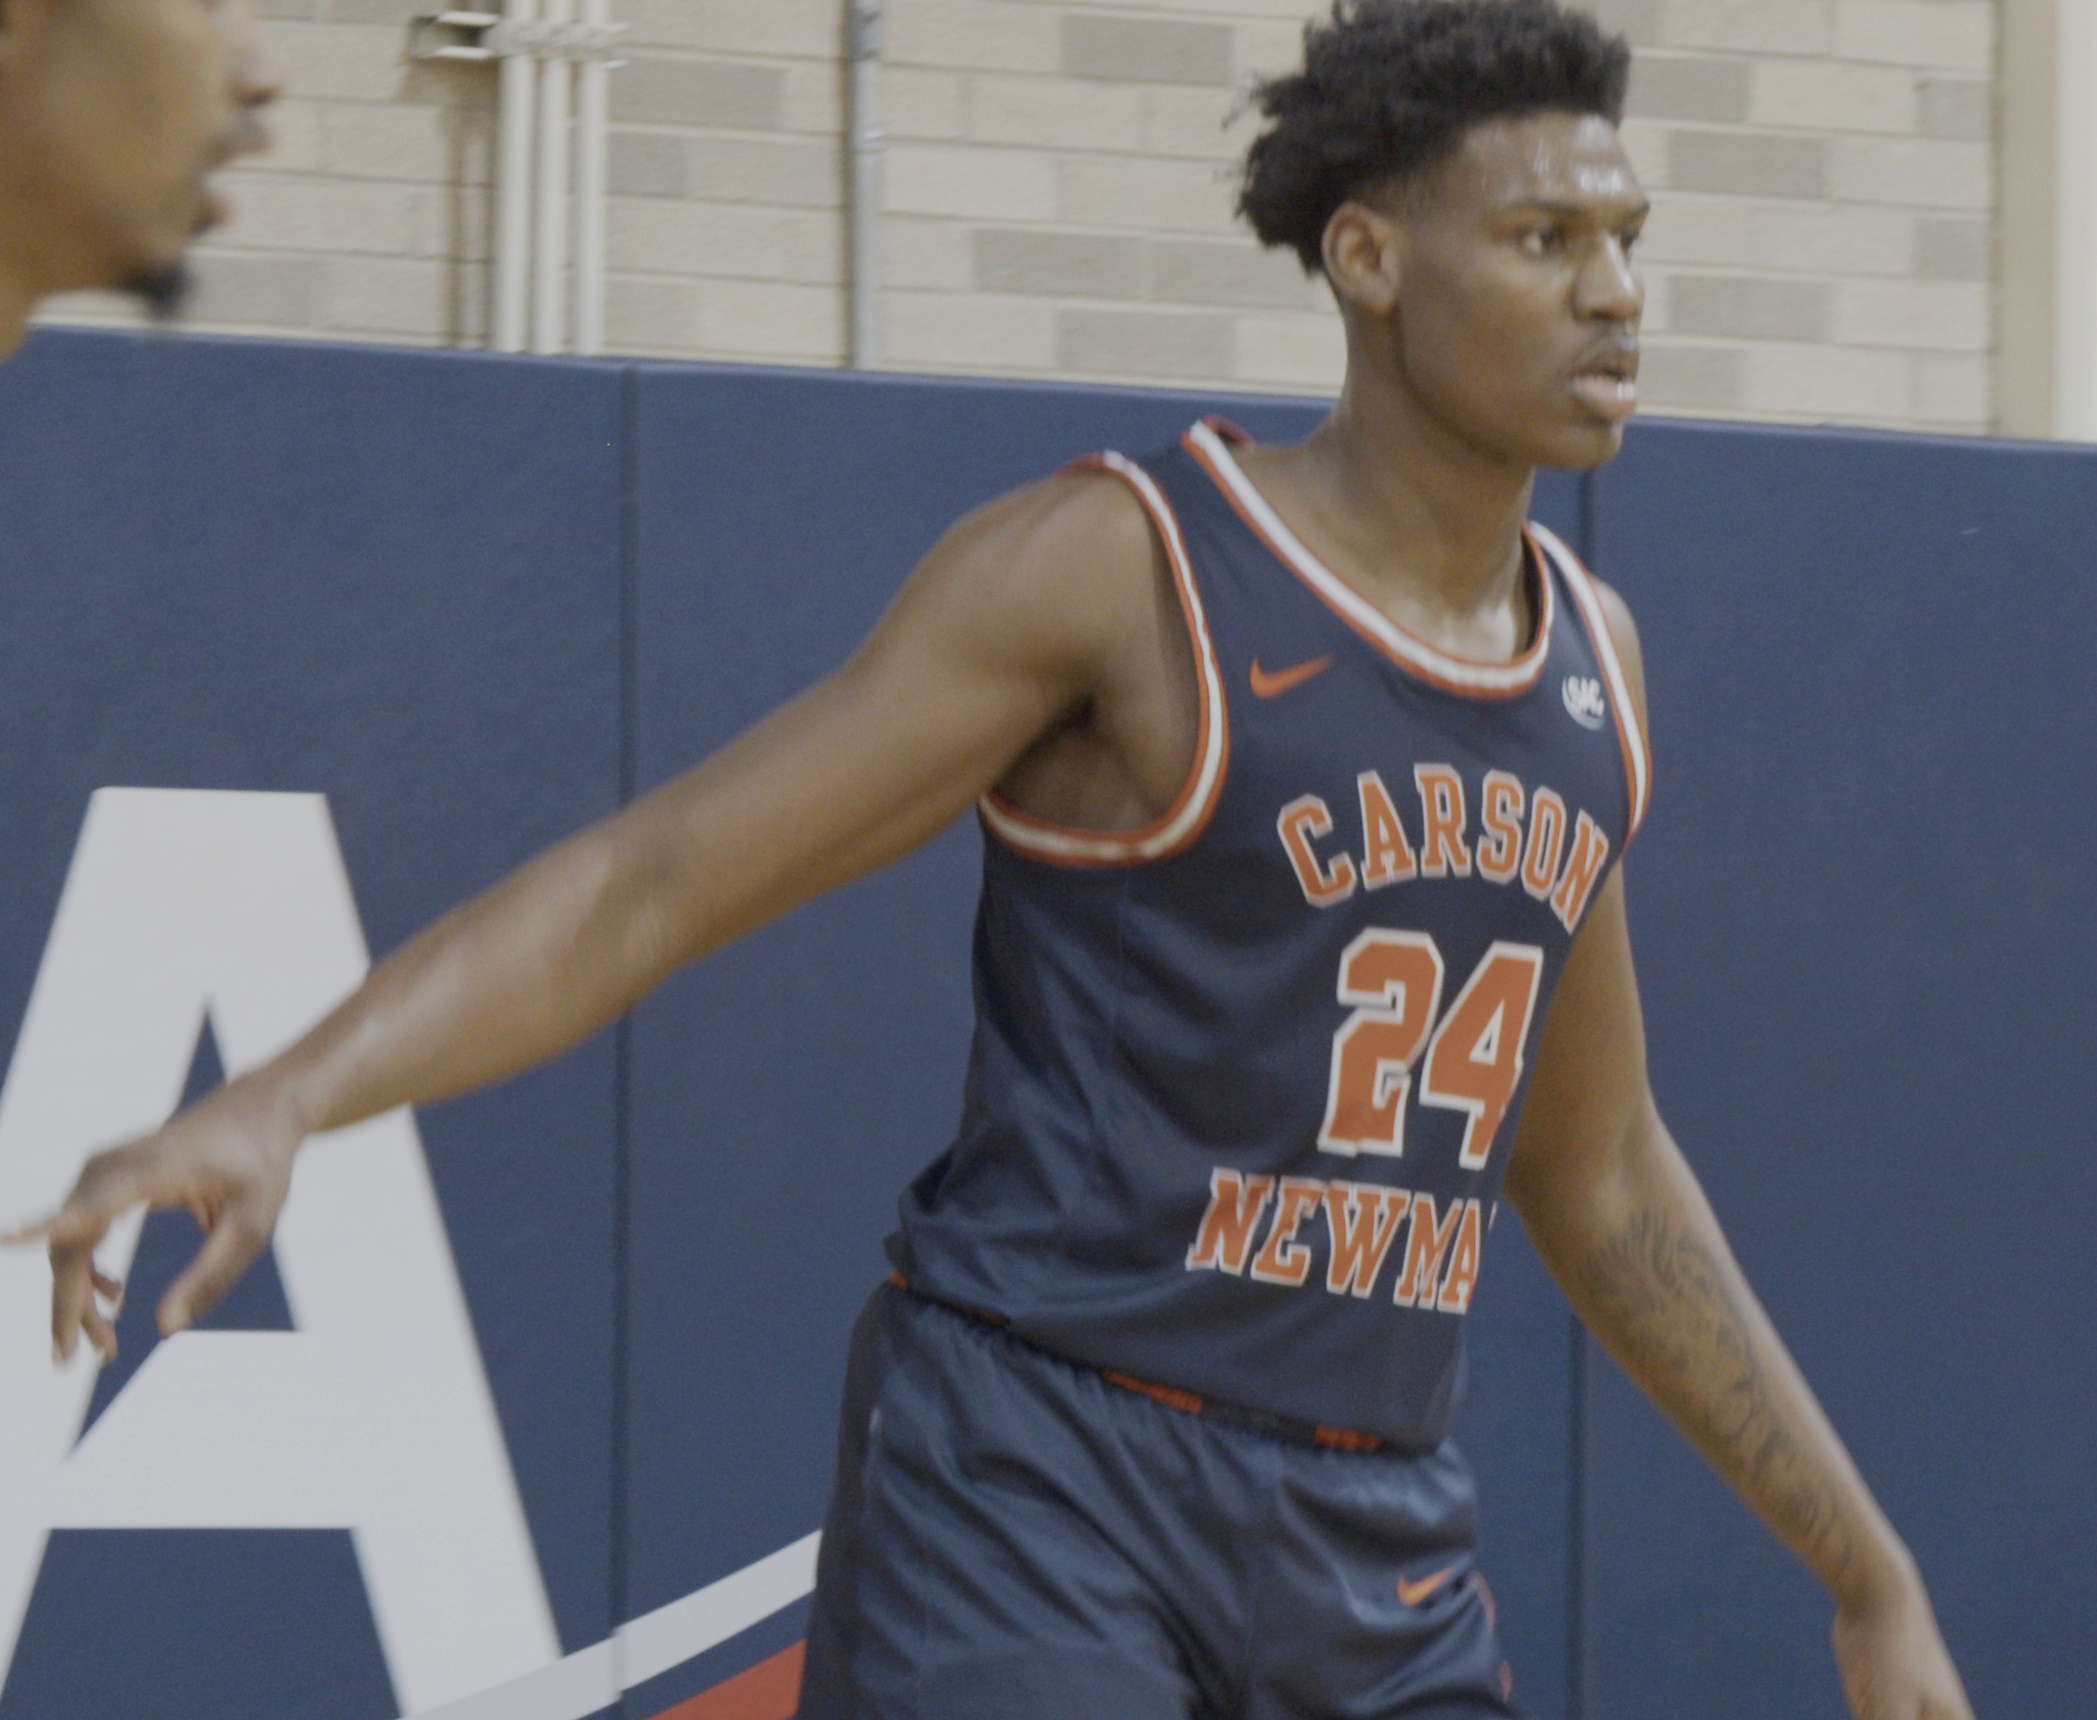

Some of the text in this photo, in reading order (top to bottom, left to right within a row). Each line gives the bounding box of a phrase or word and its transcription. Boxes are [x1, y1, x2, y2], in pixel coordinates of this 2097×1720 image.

[1276, 763, 1609, 934] CARSON
[1317, 927, 1544, 1171] 24
[1185, 1166, 1497, 1316] NEWMA
